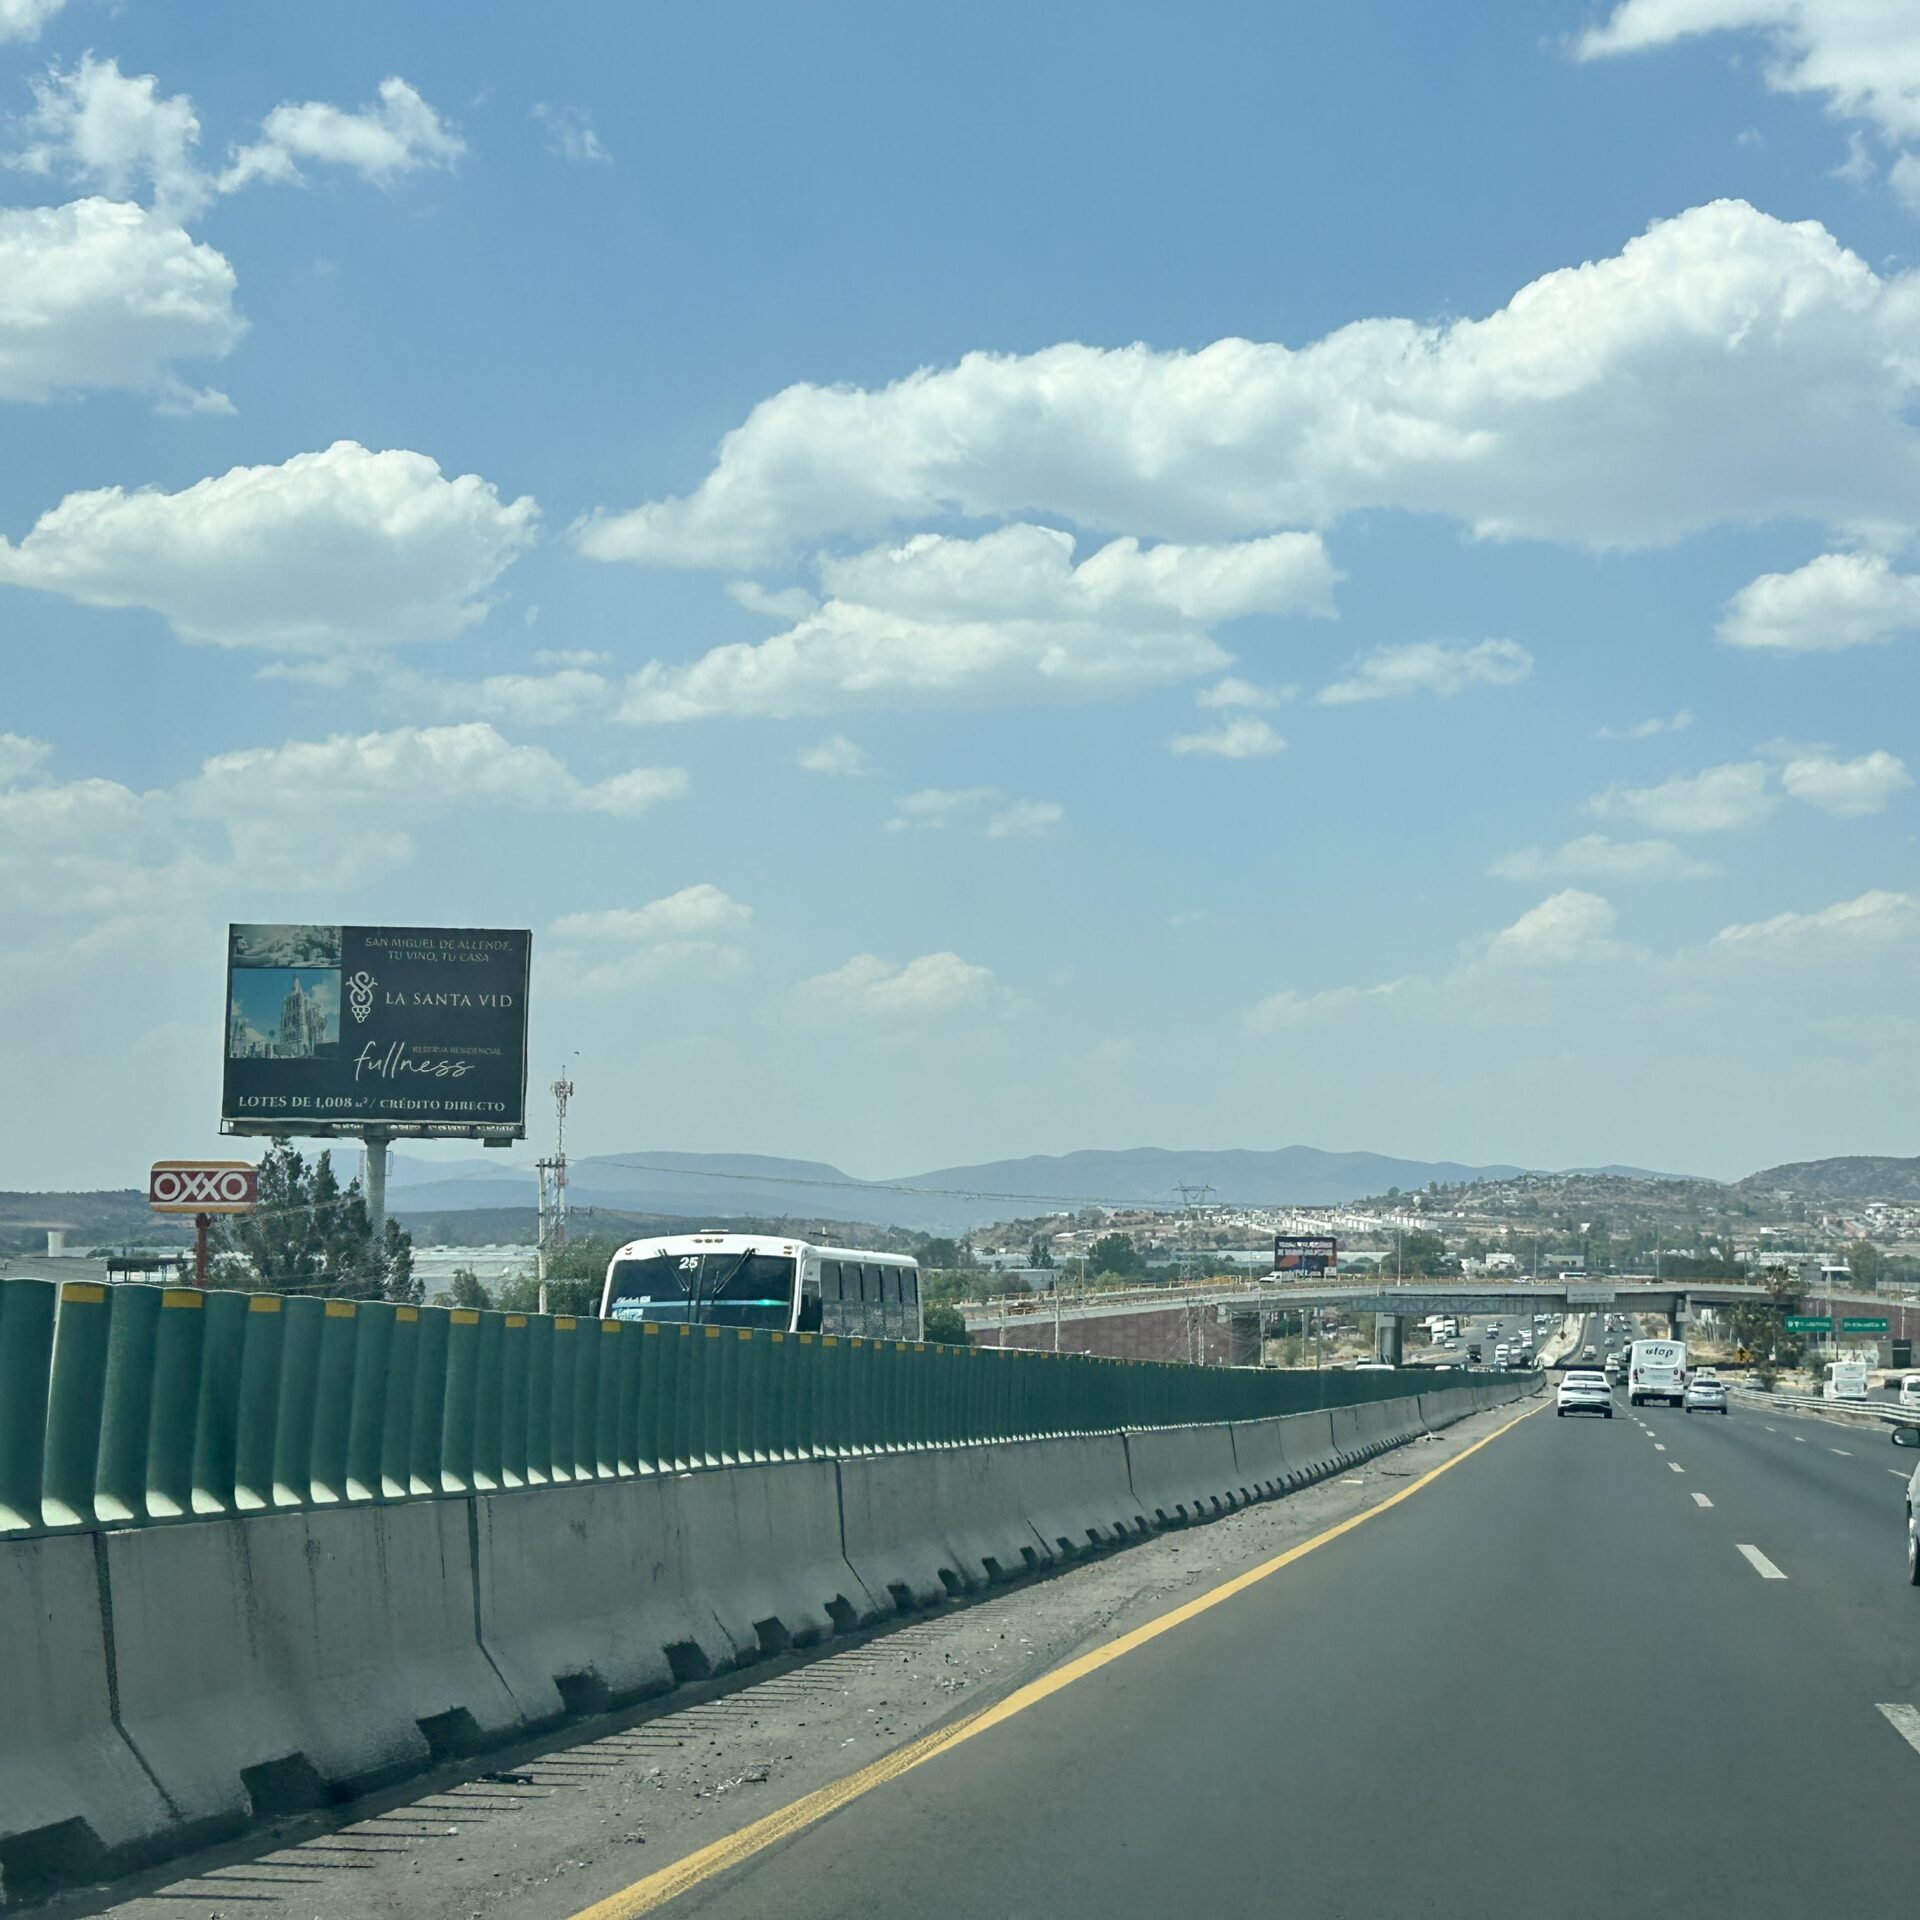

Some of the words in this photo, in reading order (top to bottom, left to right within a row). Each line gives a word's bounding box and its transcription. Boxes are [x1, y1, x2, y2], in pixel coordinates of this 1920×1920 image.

[365, 937, 388, 947] SAN
[391, 938, 435, 949] MIGUEL
[440, 940, 454, 950] DE
[388, 950, 402, 960] TU
[443, 952, 457, 962] TU
[460, 953, 489, 963] CASA
[386, 992, 406, 1005] LA
[413, 992, 472, 1007] SANTA
[479, 994, 513, 1008] VID
[353, 1040, 476, 1081] fullness
[239, 1096, 287, 1108] LOTES
[292, 1097, 311, 1108] DE
[316, 1097, 352, 1109] 1,008
[380, 1097, 440, 1110] CRÉDITO
[445, 1100, 505, 1112] DIRECTO
[153, 1171, 248, 1204] OXXO
[679, 1256, 698, 1270] 25
